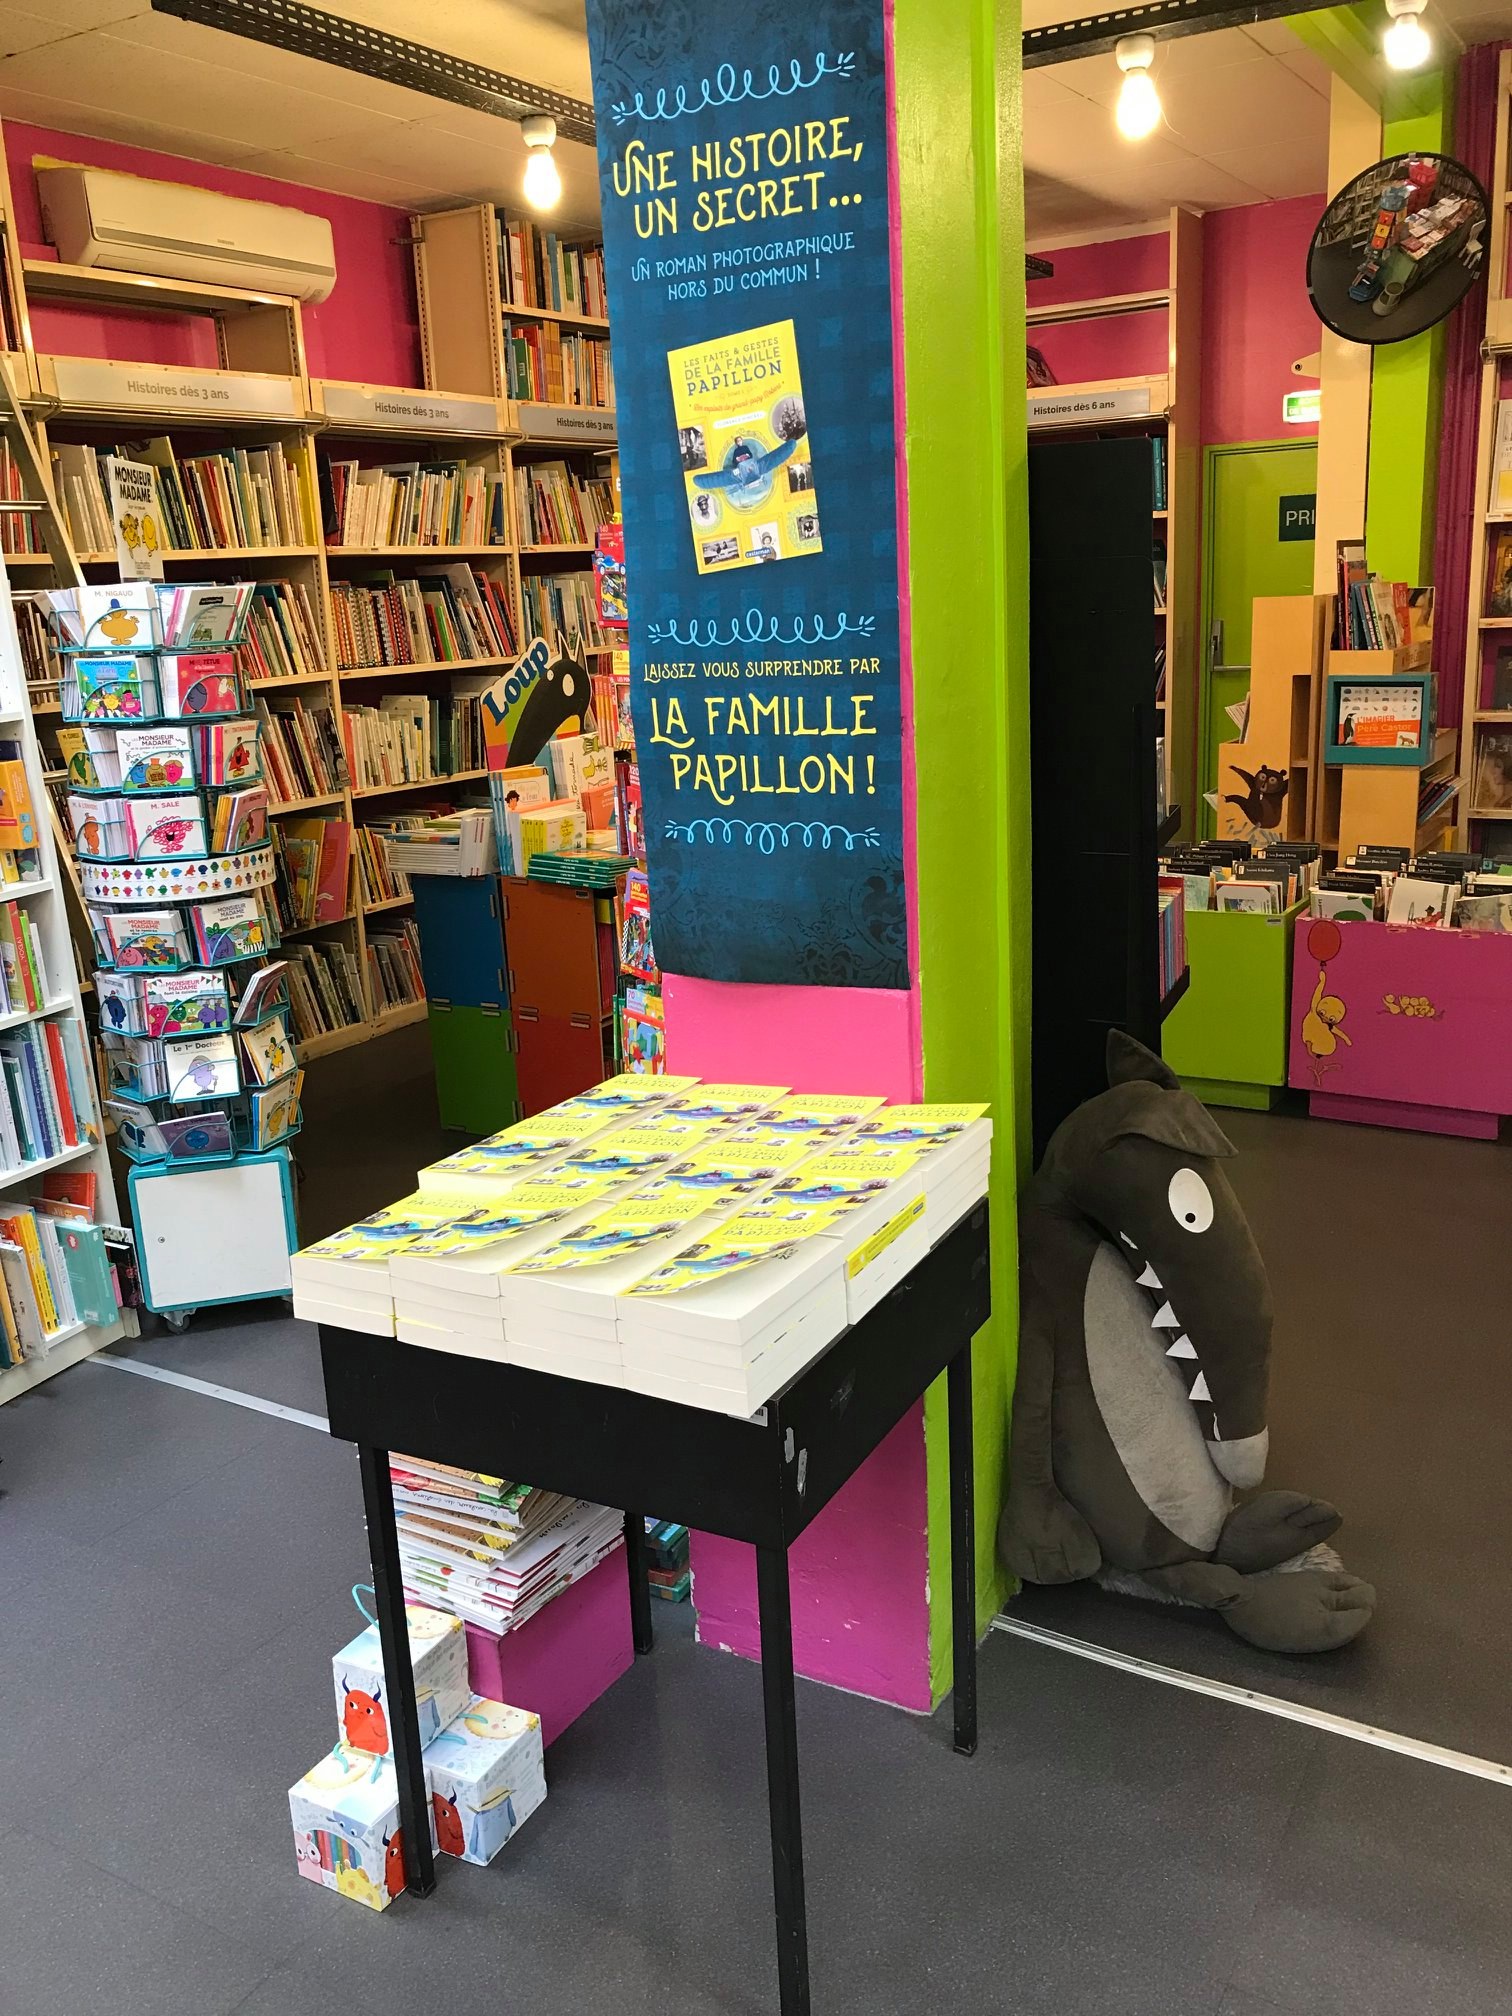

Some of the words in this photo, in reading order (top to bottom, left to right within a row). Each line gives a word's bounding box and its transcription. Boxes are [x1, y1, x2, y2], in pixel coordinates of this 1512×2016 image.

[612, 140, 677, 196] UNE
[692, 116, 863, 183] HISTOIRE,
[634, 197, 677, 238] UN
[693, 172, 862, 232] SECRET...
[632, 257, 650, 282] UN
[656, 254, 707, 280] ROMAN
[713, 232, 855, 270] PHOTOGRAPHIQUE
[668, 282, 706, 300] HORS
[714, 276, 734, 296] DU
[740, 264, 808, 290] COMMUN
[684, 358, 700, 368] LES
[704, 350, 730, 363] FAITS
[743, 337, 778, 352] GESTES
[684, 366, 702, 380] DE
[706, 363, 722, 375] LA
[726, 346, 780, 370] FAMILLE
[127, 380, 178, 398] Histoires
[202, 388, 209, 400] 3
[210, 389, 230, 400] ans
[687, 360, 782, 396] PAPILLON
[374, 402, 411, 416] Histoires
[429, 410, 434, 419] 3
[435, 410, 449, 419] ans
[1033, 404, 1072, 416] Histoires
[1092, 402, 1098, 410] 6
[1099, 400, 1116, 409] ans
[556, 418, 585, 428] Histoires
[602, 422, 614, 430] ans
[115, 466, 152, 486] MONSIEUR
[482, 641, 550, 726] Loup
[644, 661, 696, 684] LAISSEZ
[702, 662, 740, 678] VOUS
[746, 660, 843, 678] SURPRENDRE
[850, 658, 880, 674] PAR
[650, 698, 695, 748] LA
[704, 693, 876, 736] FAMILLE
[1382, 724, 1412, 732] Castor
[670, 753, 854, 806] PAPILLON
[630, 882, 640, 892] 140
[217, 903, 246, 912] MONSIEUR
[220, 909, 244, 917] MADAME
[628, 992, 636, 1000] 70
